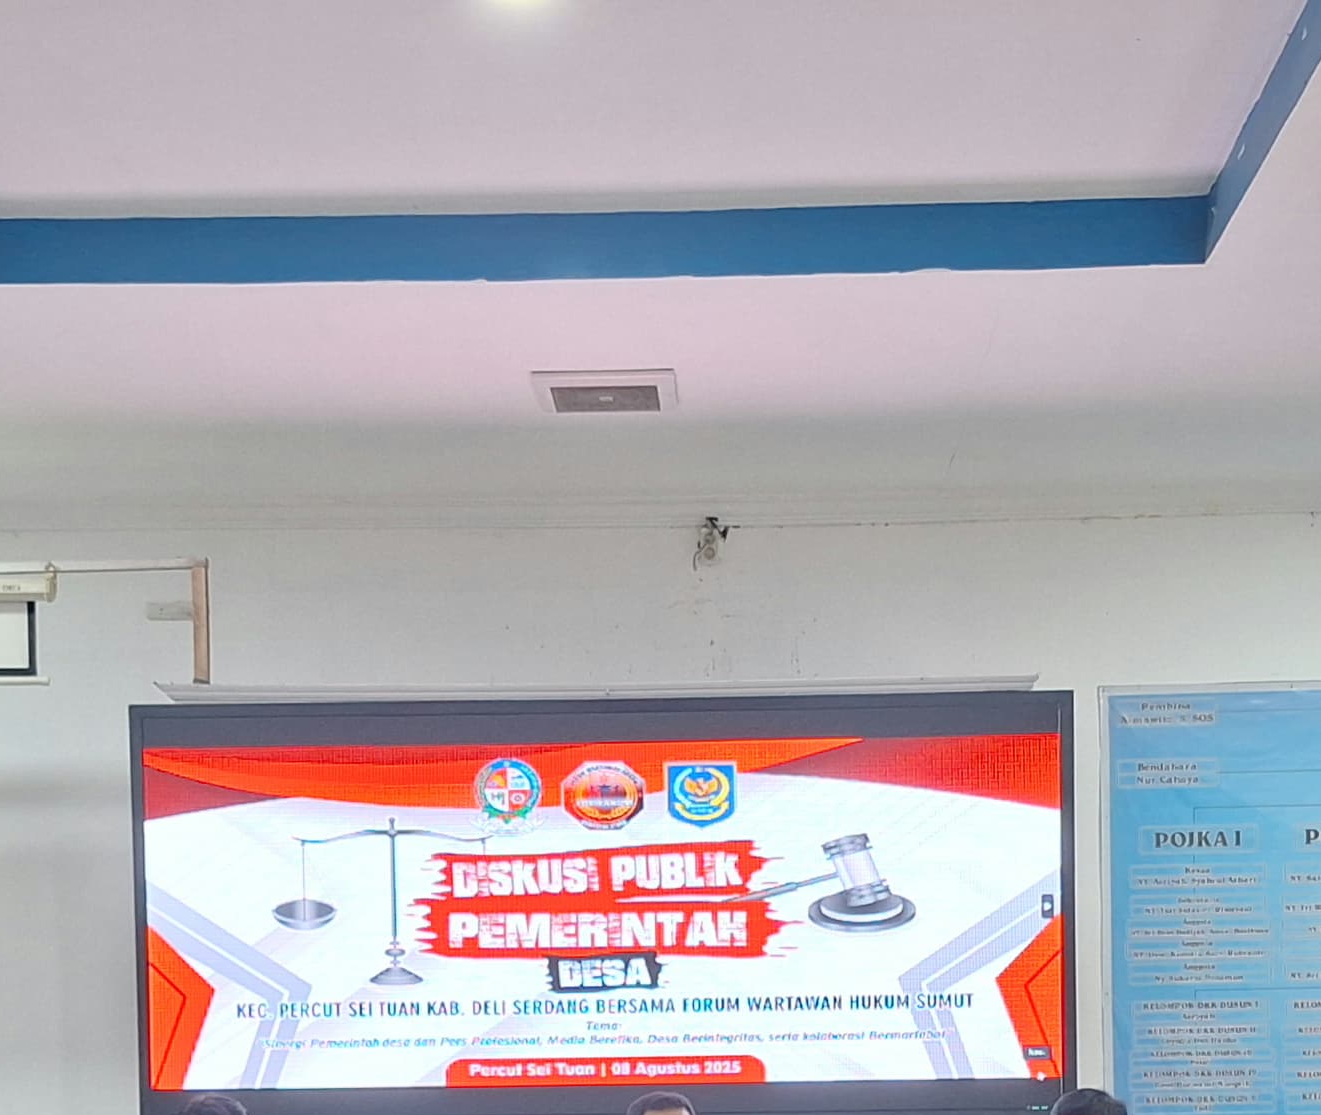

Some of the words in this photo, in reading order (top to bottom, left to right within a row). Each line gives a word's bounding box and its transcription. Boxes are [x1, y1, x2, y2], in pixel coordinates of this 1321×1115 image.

[1154, 830, 1228, 849] POJKA
[1234, 830, 1242, 847] I
[451, 856, 600, 898] DISKUSI
[609, 851, 744, 892] PUBLIK
[447, 910, 748, 949] PEMERINTAH
[557, 957, 653, 989] DESA
[279, 1001, 342, 1018] PERCUT
[348, 1000, 373, 1017] SEI
[378, 1000, 421, 1017] TUAN
[427, 999, 465, 1017] KAB.
[472, 999, 507, 1016] DELI
[511, 998, 590, 1015] SERDANG
[596, 997, 676, 1014] BERSAMA
[682, 996, 741, 1013] FORUM
[747, 995, 843, 1012] WARTAWAN
[849, 993, 910, 1010] HUKUM
[916, 992, 975, 1009] SUMUT
[468, 1062, 522, 1078] Percut
[527, 1062, 552, 1077] Sei
[555, 1062, 595, 1076] Tuan
[635, 1060, 700, 1077] Agustus
[704, 1060, 742, 1075] 2025
